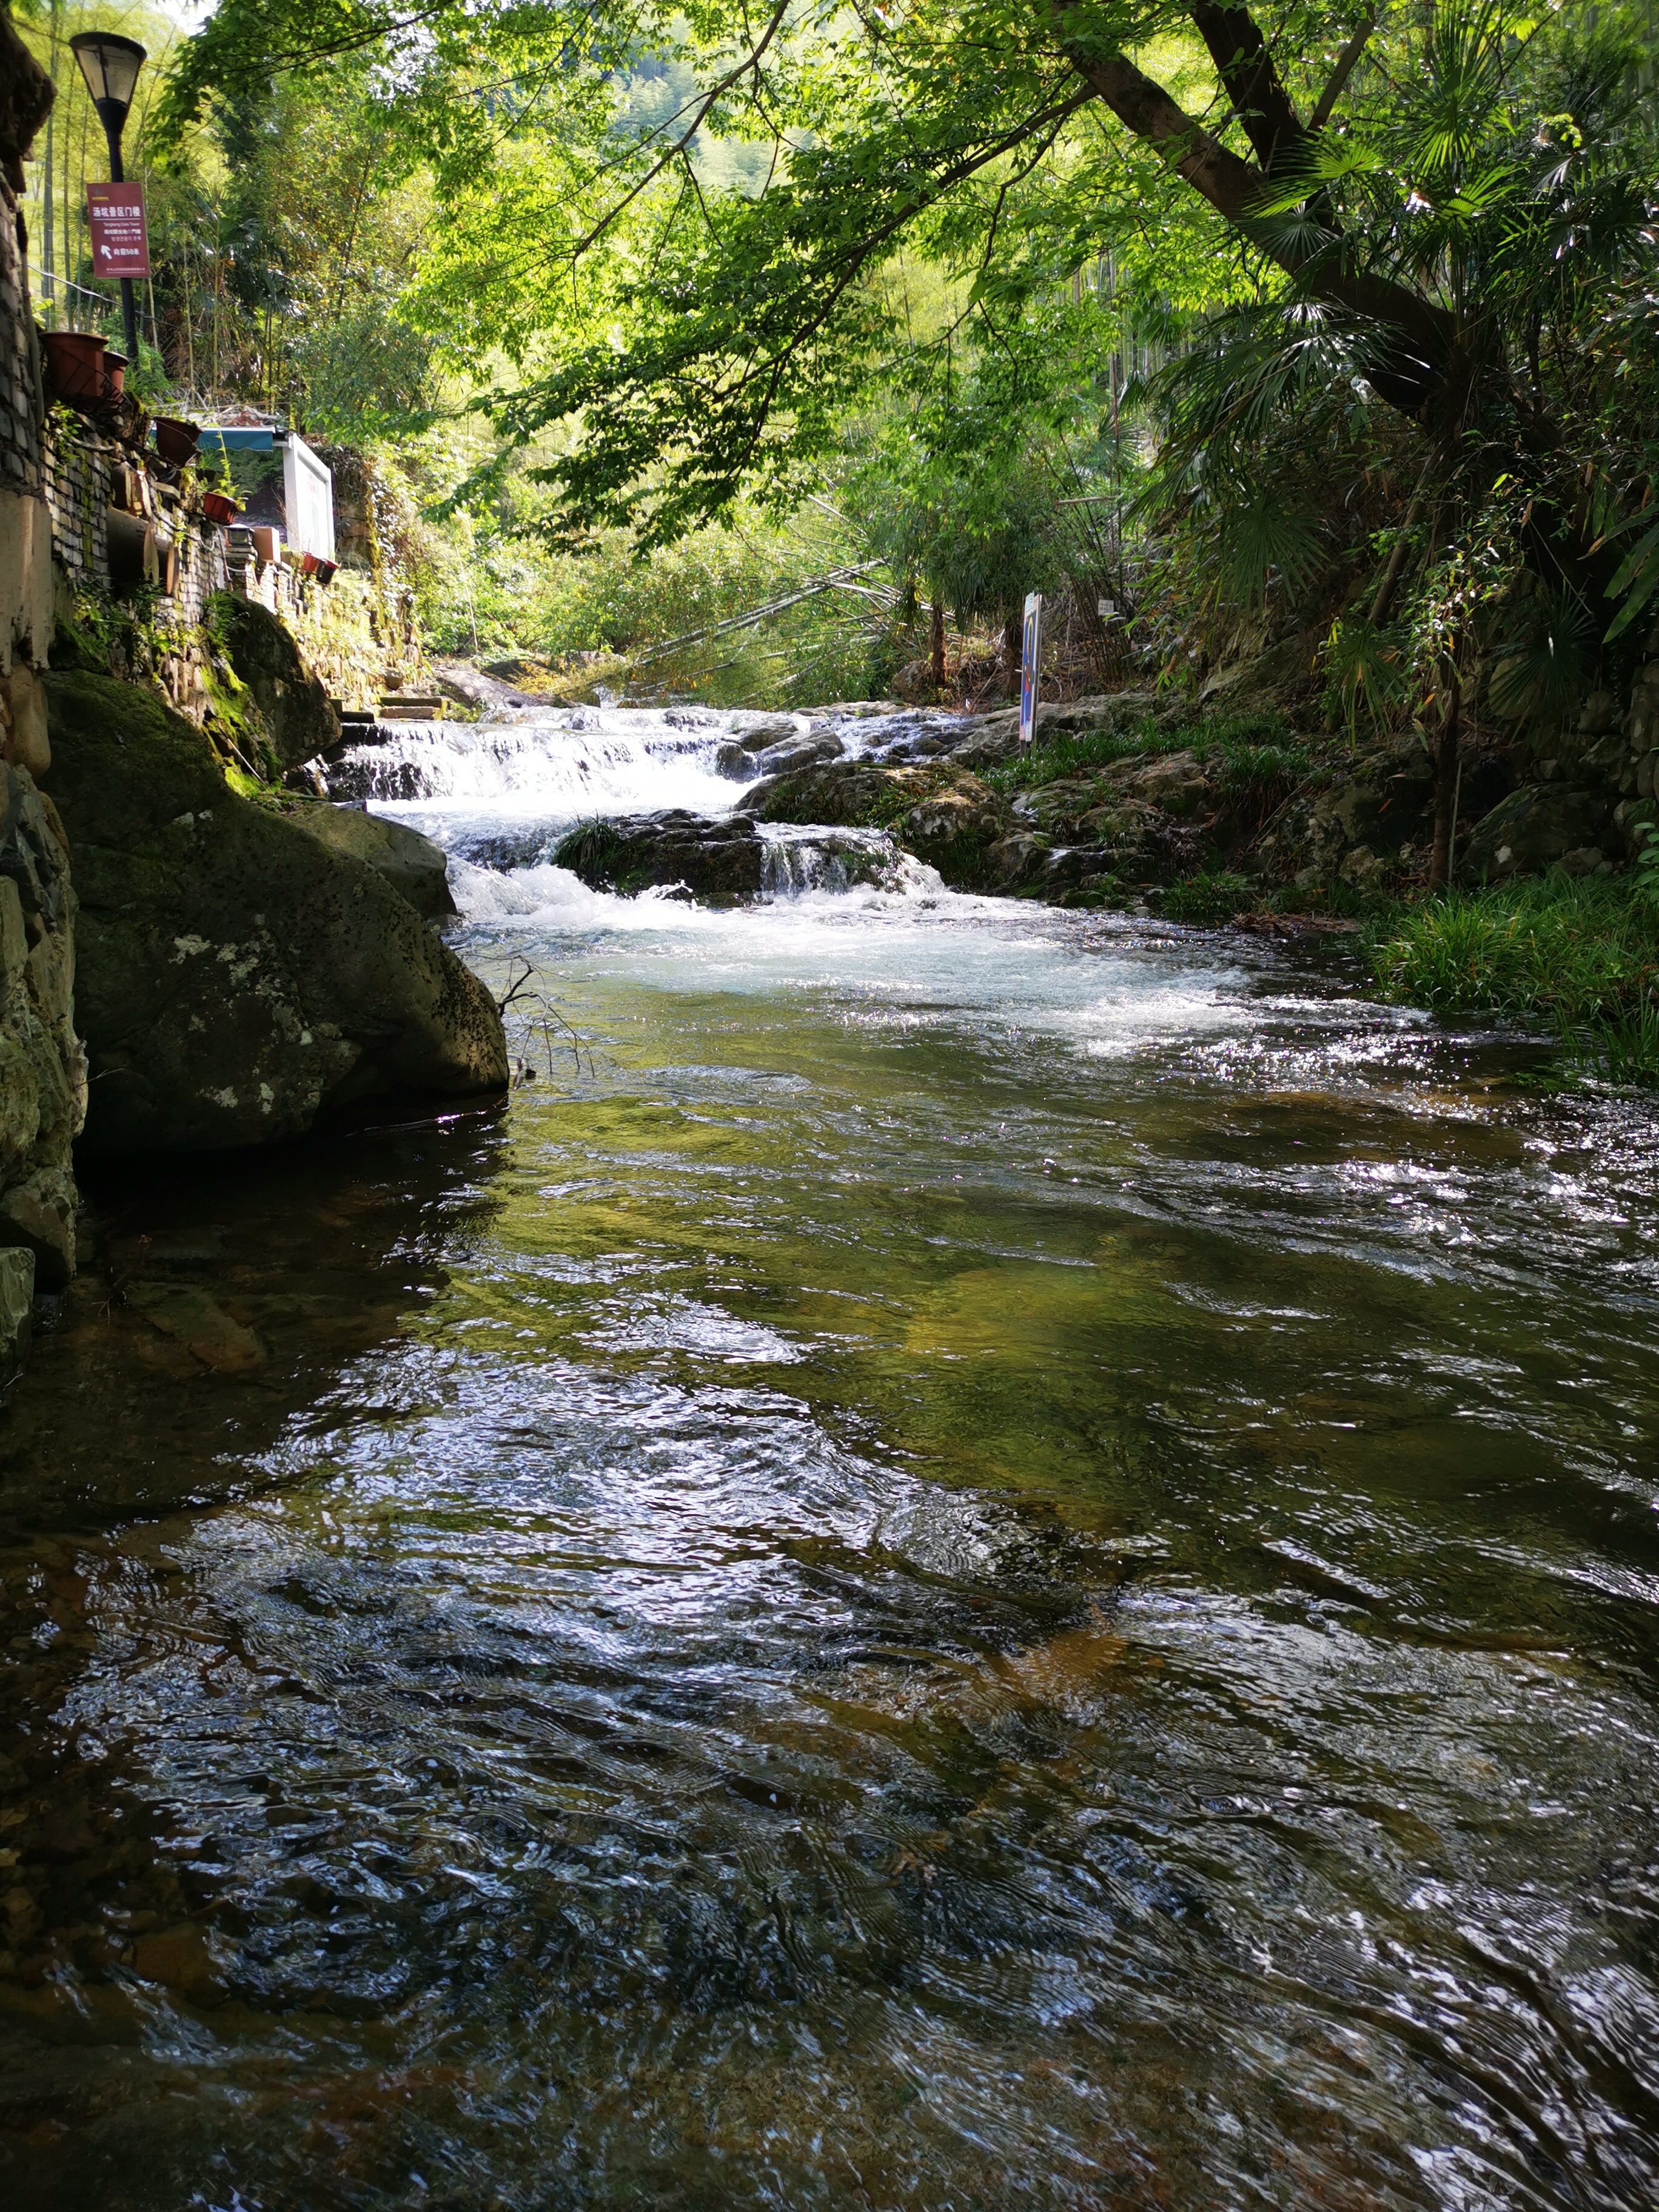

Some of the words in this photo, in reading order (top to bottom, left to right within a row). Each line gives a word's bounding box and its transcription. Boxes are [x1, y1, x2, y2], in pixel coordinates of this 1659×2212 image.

[93, 206, 141, 216] 汤坑景区门楼
